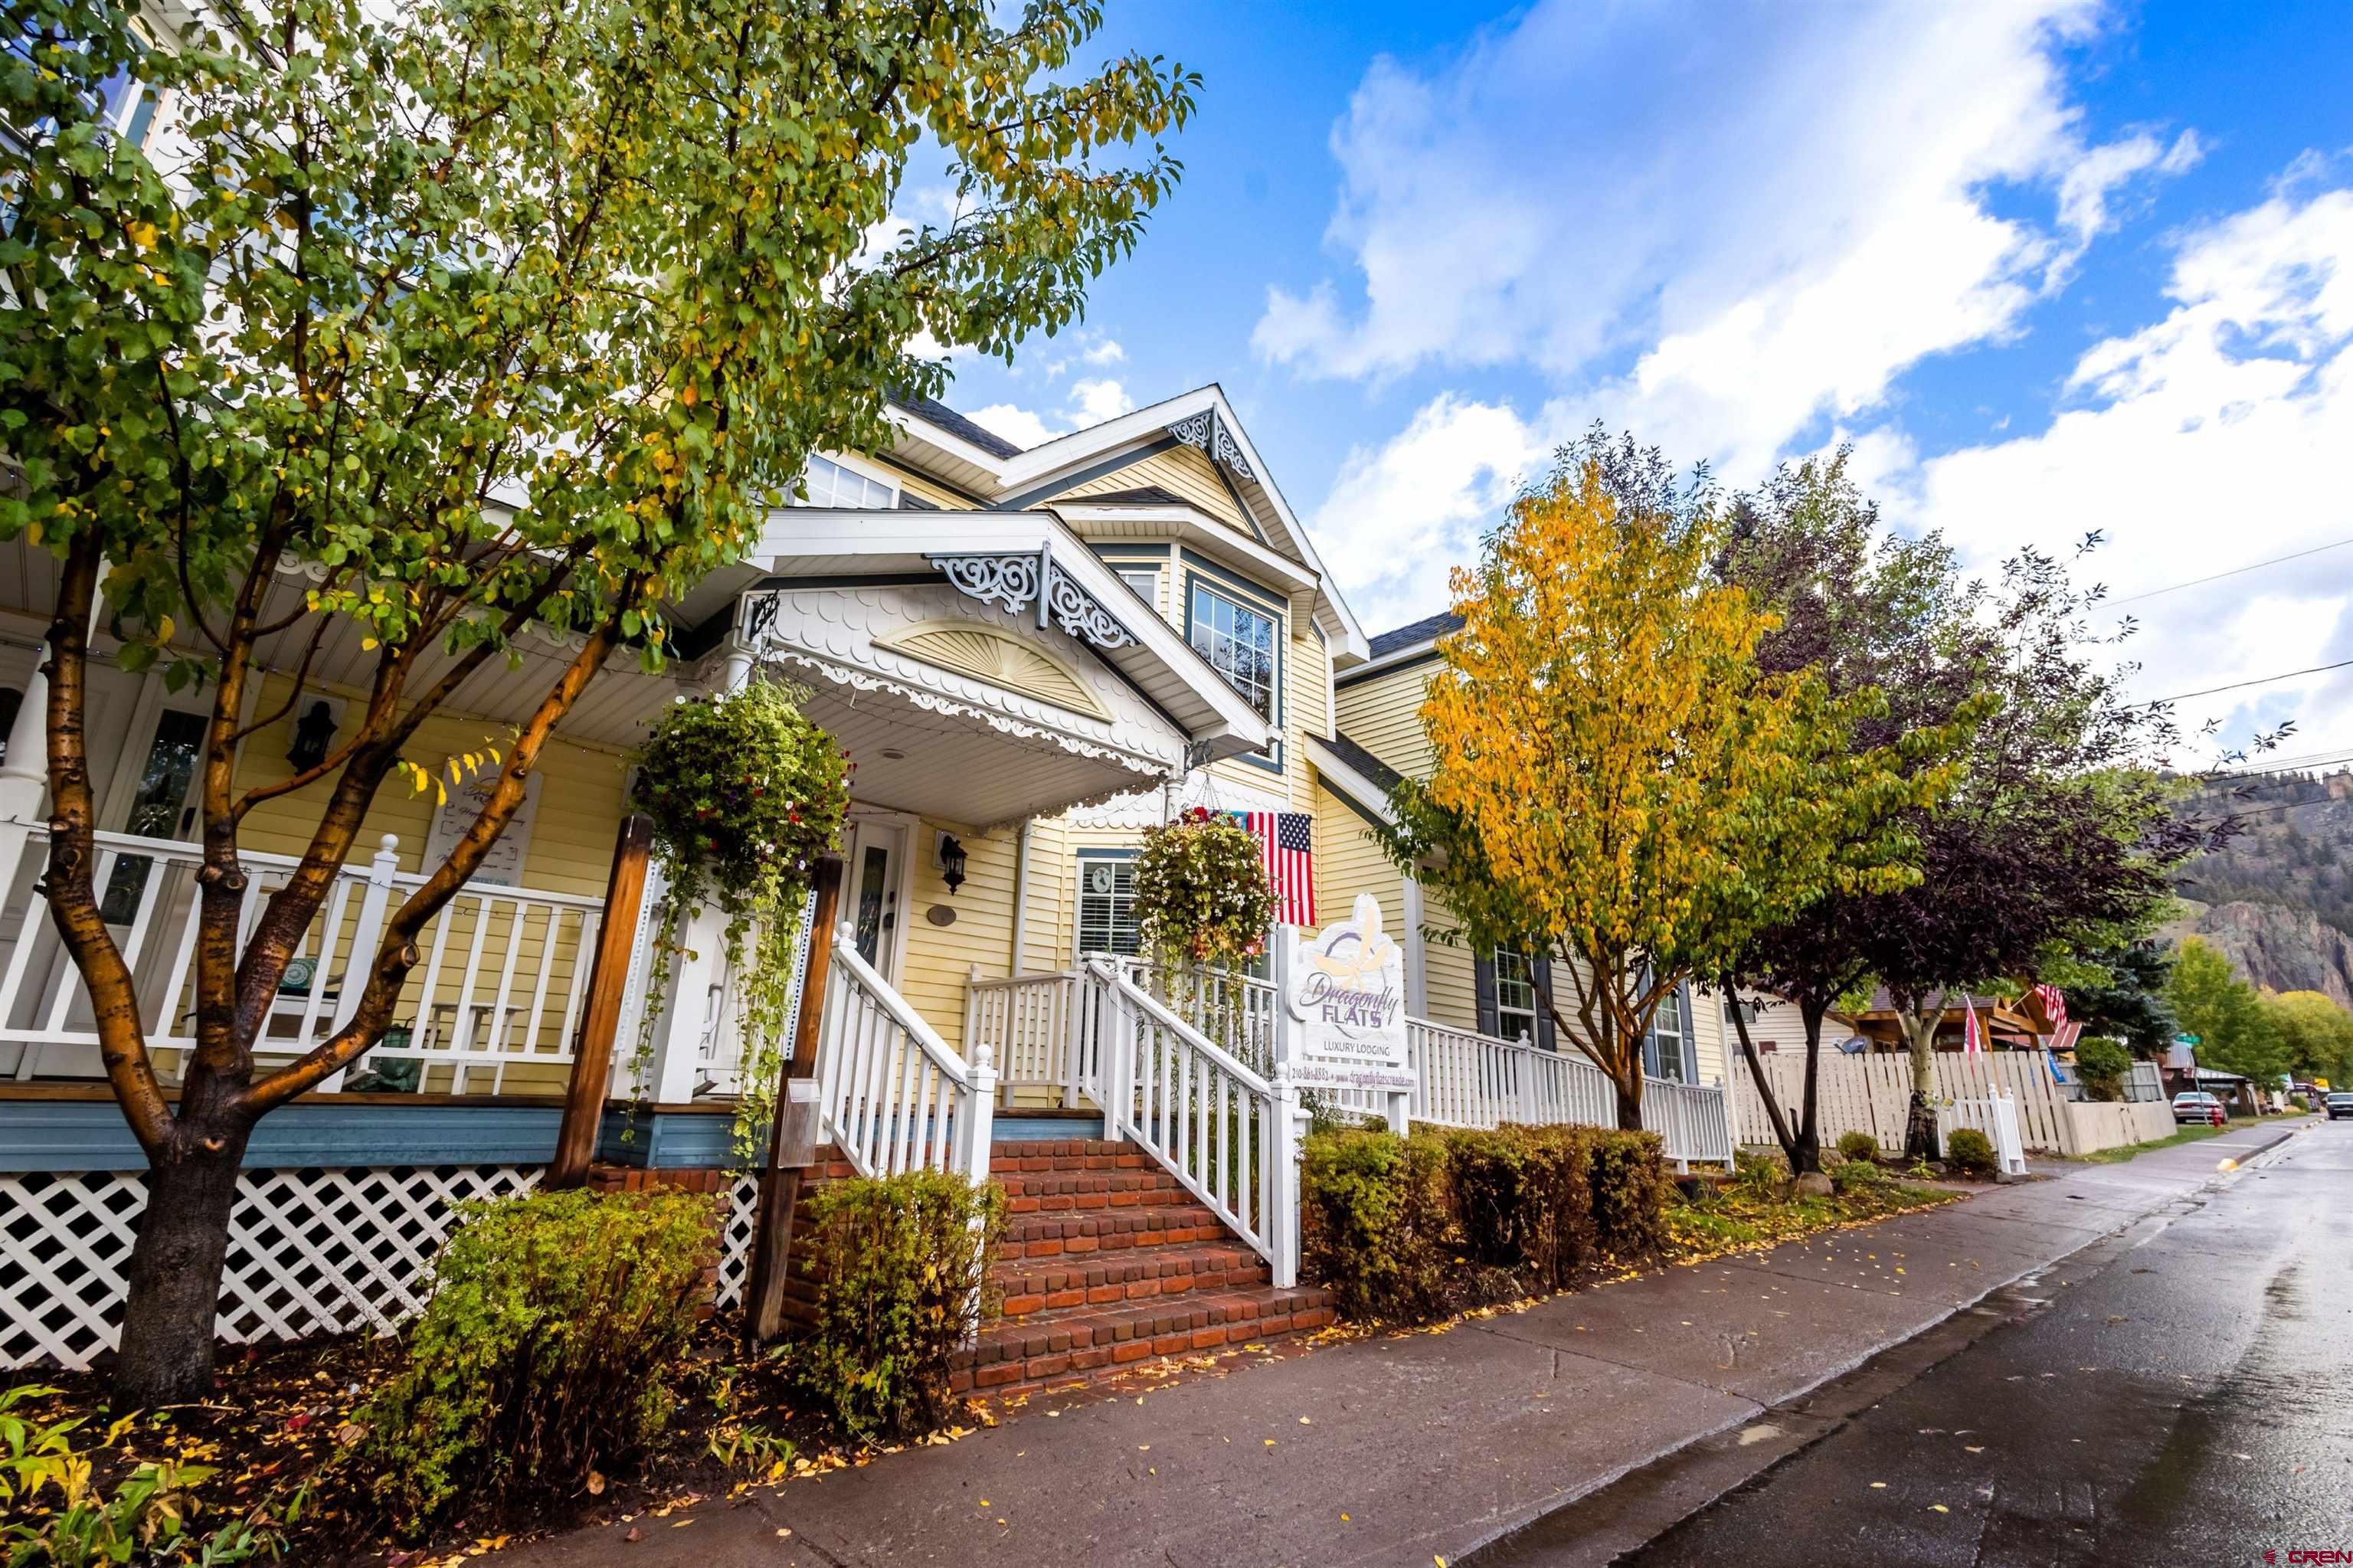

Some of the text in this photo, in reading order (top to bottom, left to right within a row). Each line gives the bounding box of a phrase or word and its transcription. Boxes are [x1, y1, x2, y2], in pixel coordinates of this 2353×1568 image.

[1299, 972, 1399, 1026] Dragonfly
[1322, 1004, 1382, 1028] FLATS
[1324, 1040, 1390, 1056] LUXURY LODGING
